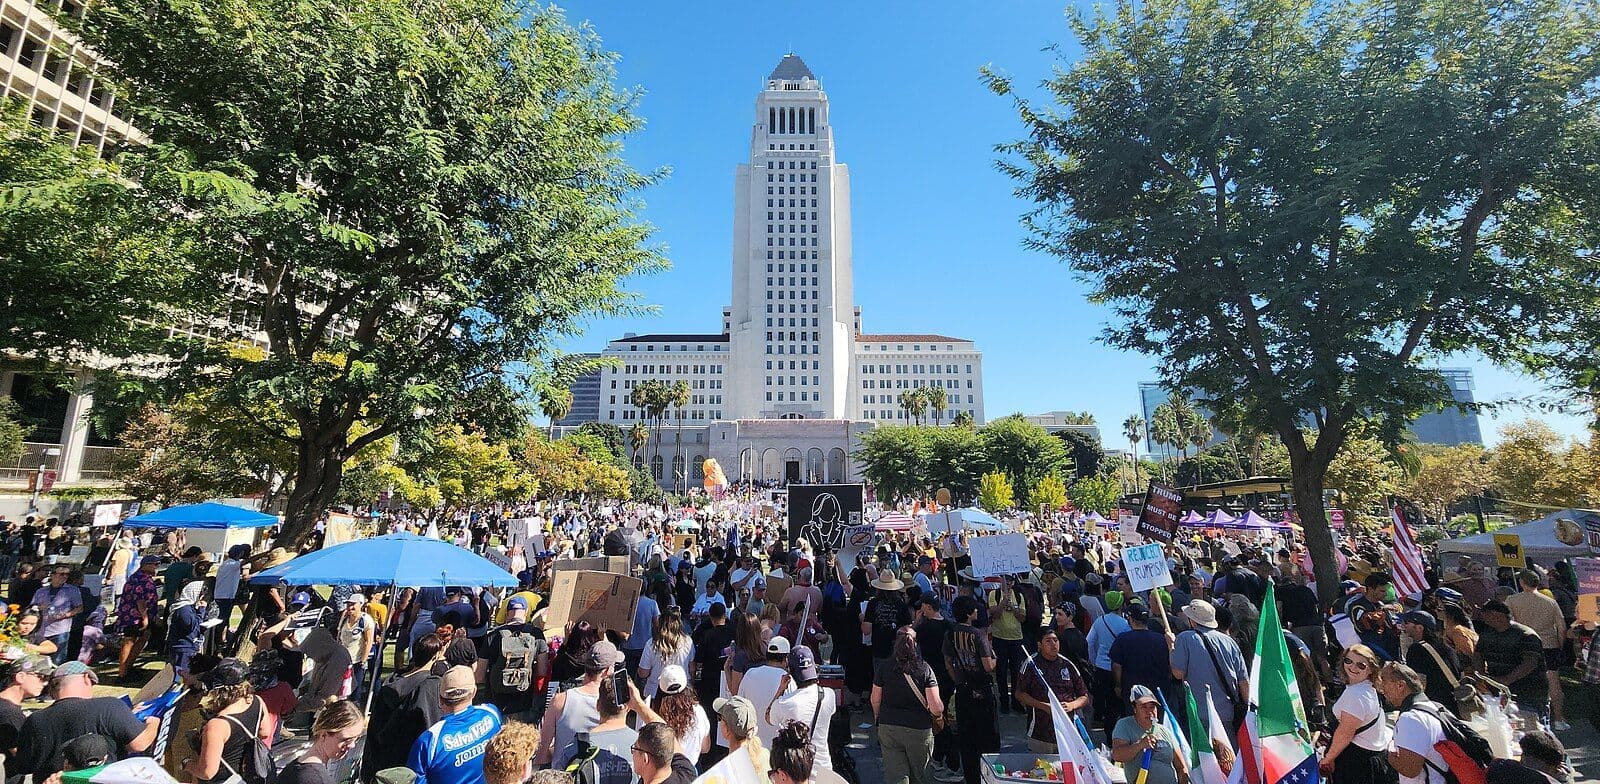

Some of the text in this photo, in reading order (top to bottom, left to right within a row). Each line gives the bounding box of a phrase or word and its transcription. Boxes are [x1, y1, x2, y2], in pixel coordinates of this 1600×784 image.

[1152, 485, 1182, 503] TRUMP
[1146, 504, 1178, 521] MUST BE
[1141, 522, 1172, 539] STOPPED
